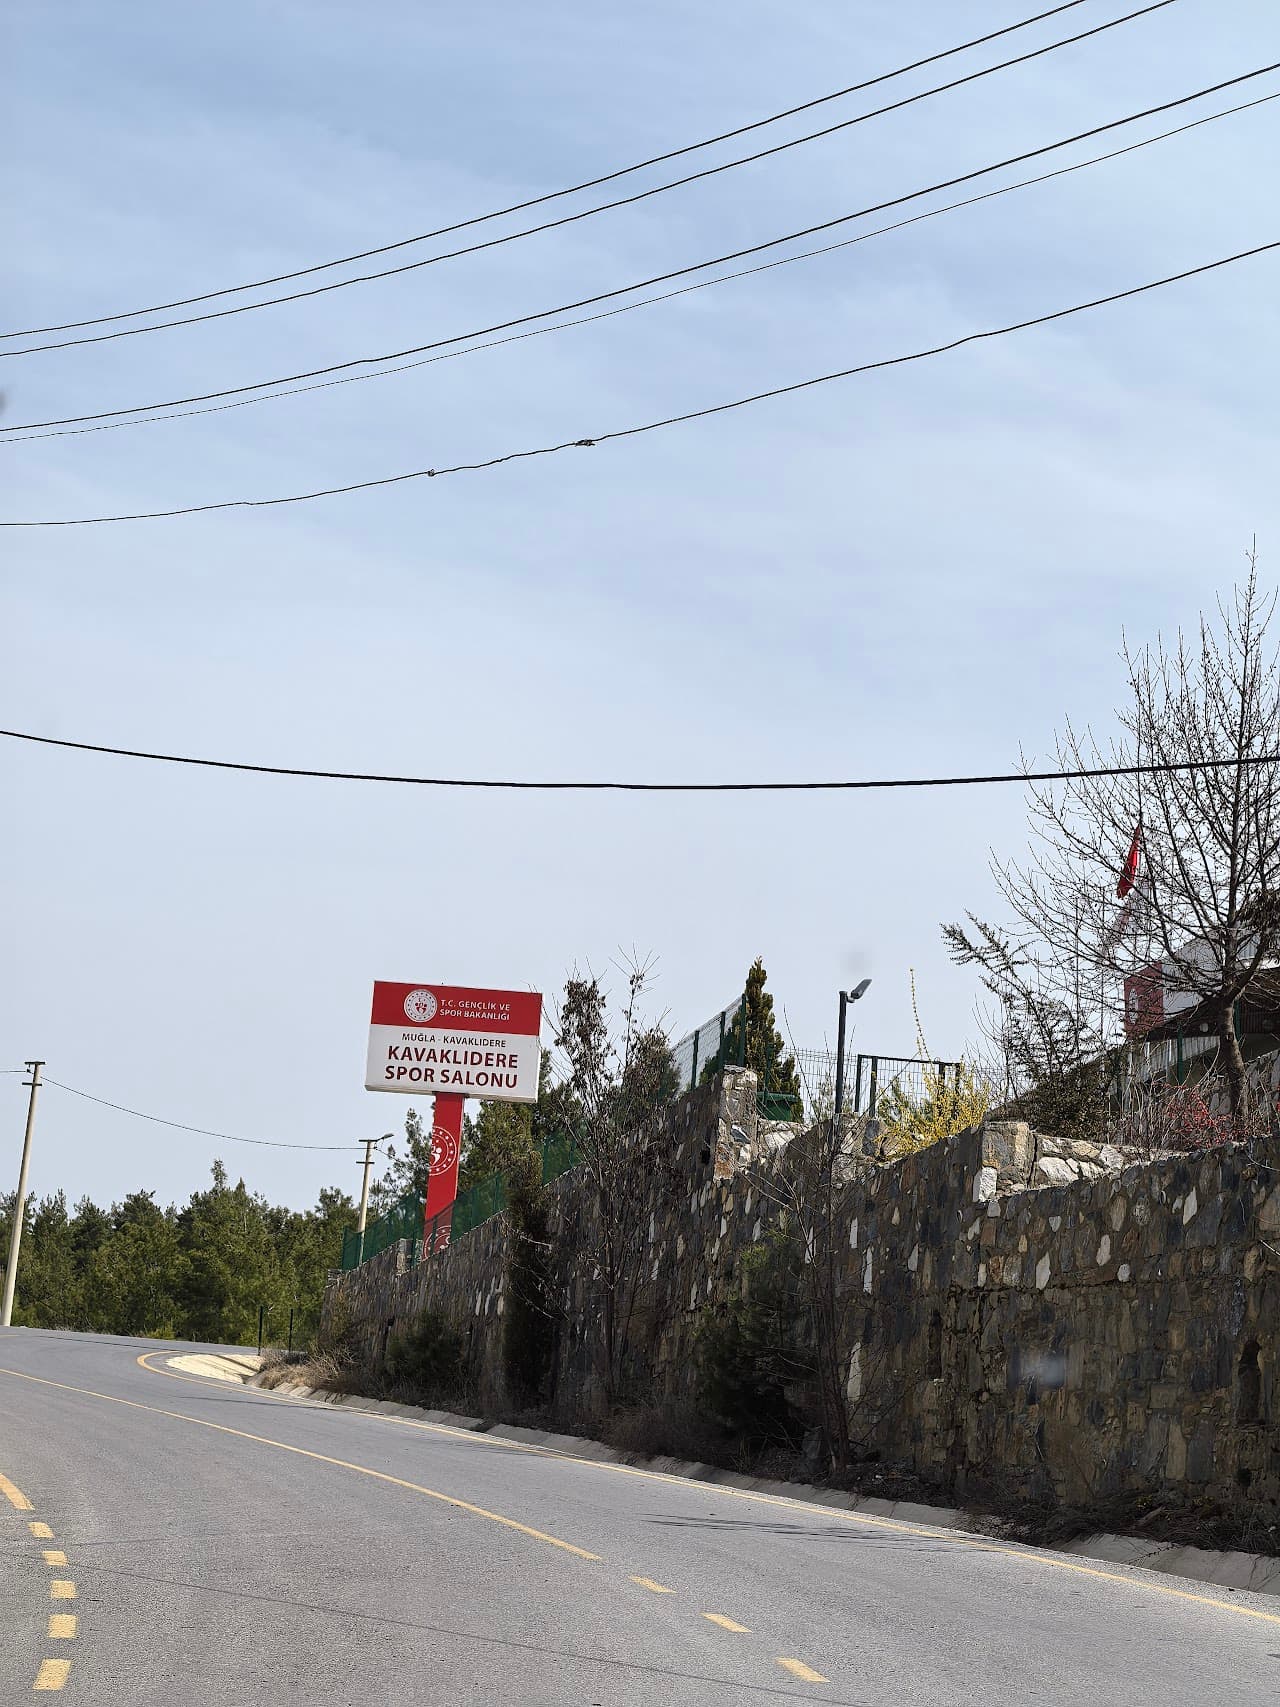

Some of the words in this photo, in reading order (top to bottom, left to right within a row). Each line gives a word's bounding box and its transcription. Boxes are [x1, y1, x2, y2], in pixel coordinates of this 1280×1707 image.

[440, 999, 456, 1008] T.C.
[458, 1000, 497, 1011] GENÇLİK
[499, 1003, 511, 1011] VE
[439, 1008, 462, 1017] SPOR
[464, 1010, 510, 1021] BAKANLIĞI
[401, 1032, 436, 1043] MUĞLA
[443, 1035, 507, 1048] KAVAKLIDERE
[388, 1045, 518, 1069] KAVAKLIDERE
[384, 1065, 435, 1083] SPOR
[440, 1069, 518, 1089] SALONU
